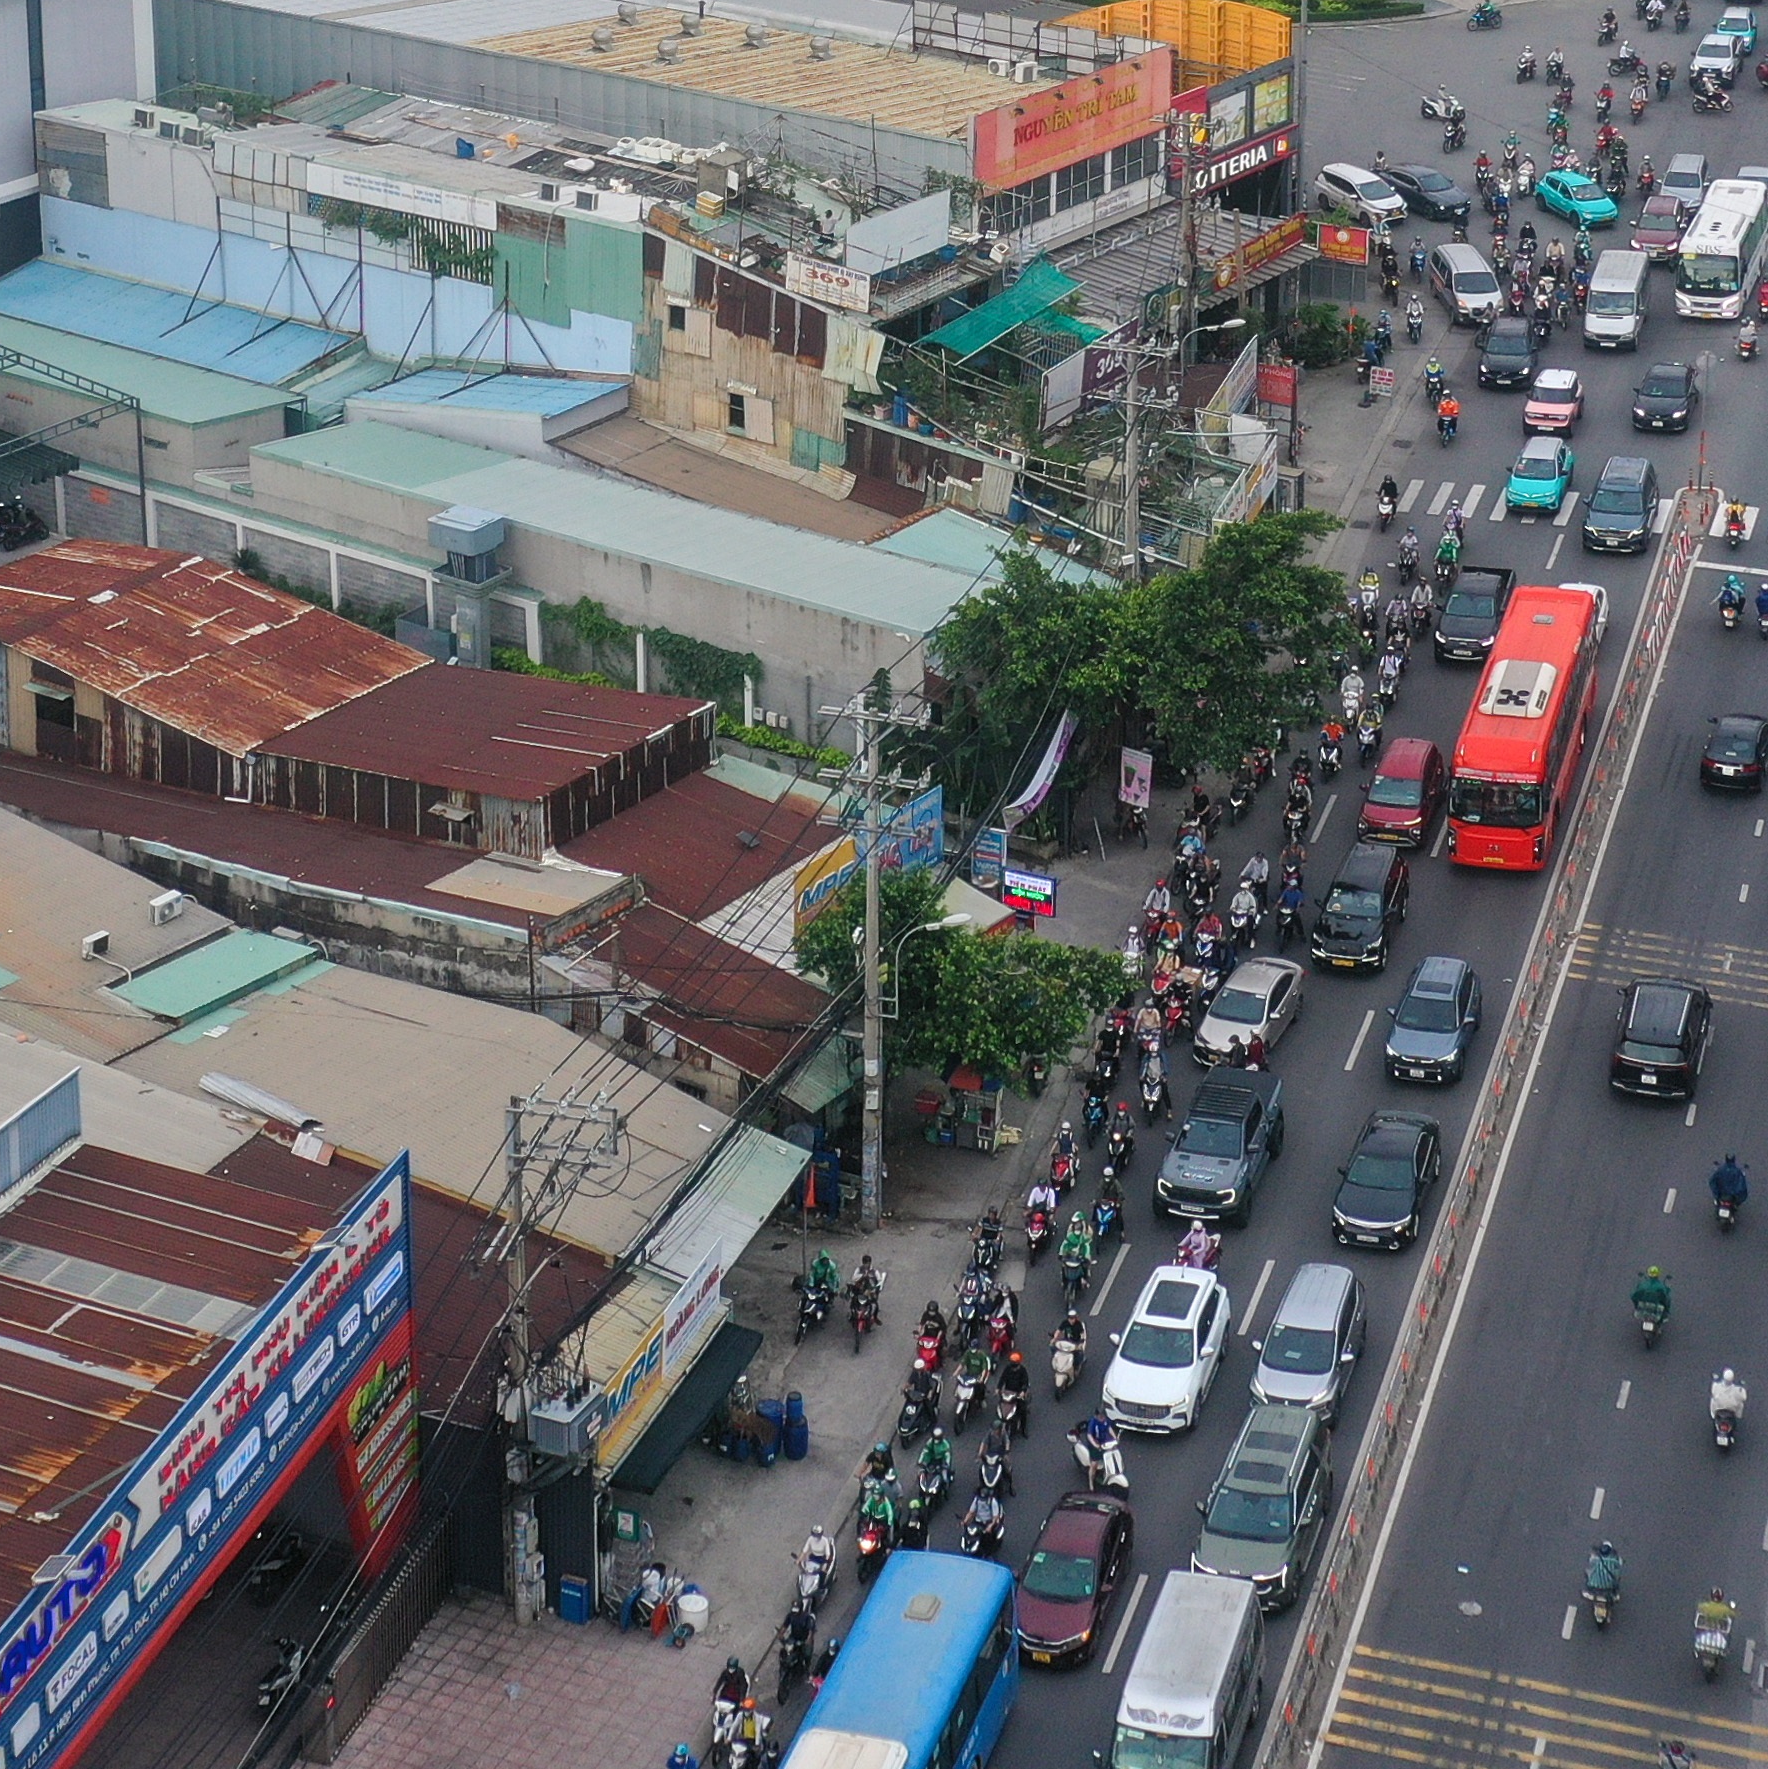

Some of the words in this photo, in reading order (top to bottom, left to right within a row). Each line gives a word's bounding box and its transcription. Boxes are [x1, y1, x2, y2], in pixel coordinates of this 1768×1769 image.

[1188, 144, 1267, 193] OTTERIA
[342, 1312, 360, 1341] GTR
[607, 1333, 661, 1419] MPE
[59, 1640, 96, 1692] FOCAL
